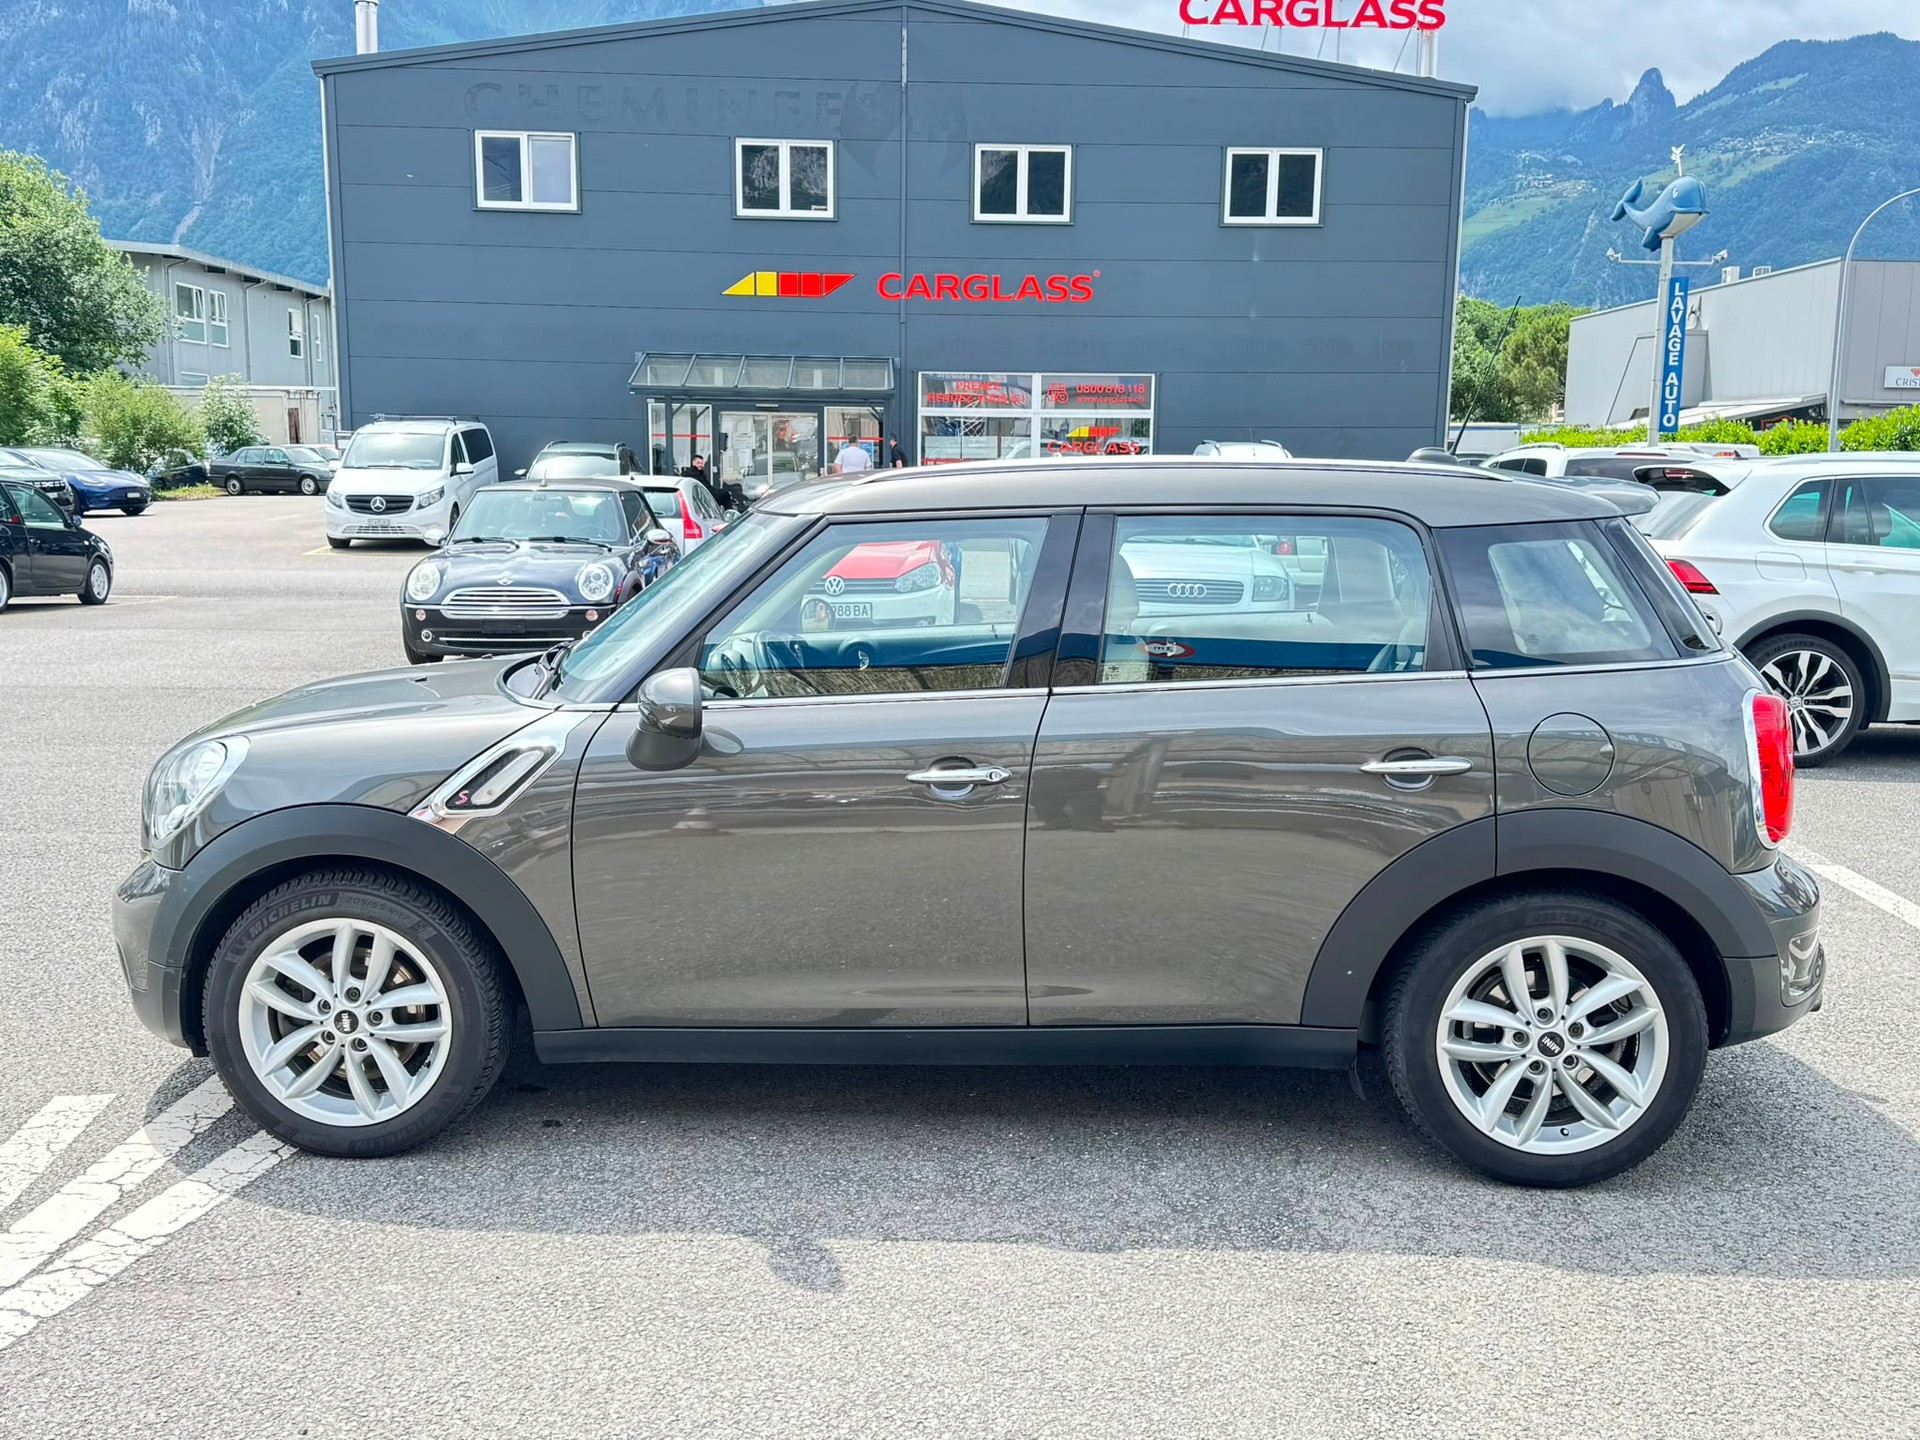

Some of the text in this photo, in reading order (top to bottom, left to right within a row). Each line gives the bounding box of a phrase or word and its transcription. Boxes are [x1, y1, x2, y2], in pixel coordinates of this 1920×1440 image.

[1179, 0, 1446, 31] CARGLASS
[1662, 282, 1685, 427] LAVAGE AUTO
[1046, 440, 1140, 454] CARGLASS
[346, 898, 385, 911] 205/55
[249, 894, 331, 937] MICHELIN
[341, 1013, 351, 1032] MINI
[1541, 1036, 1561, 1053] MINI
